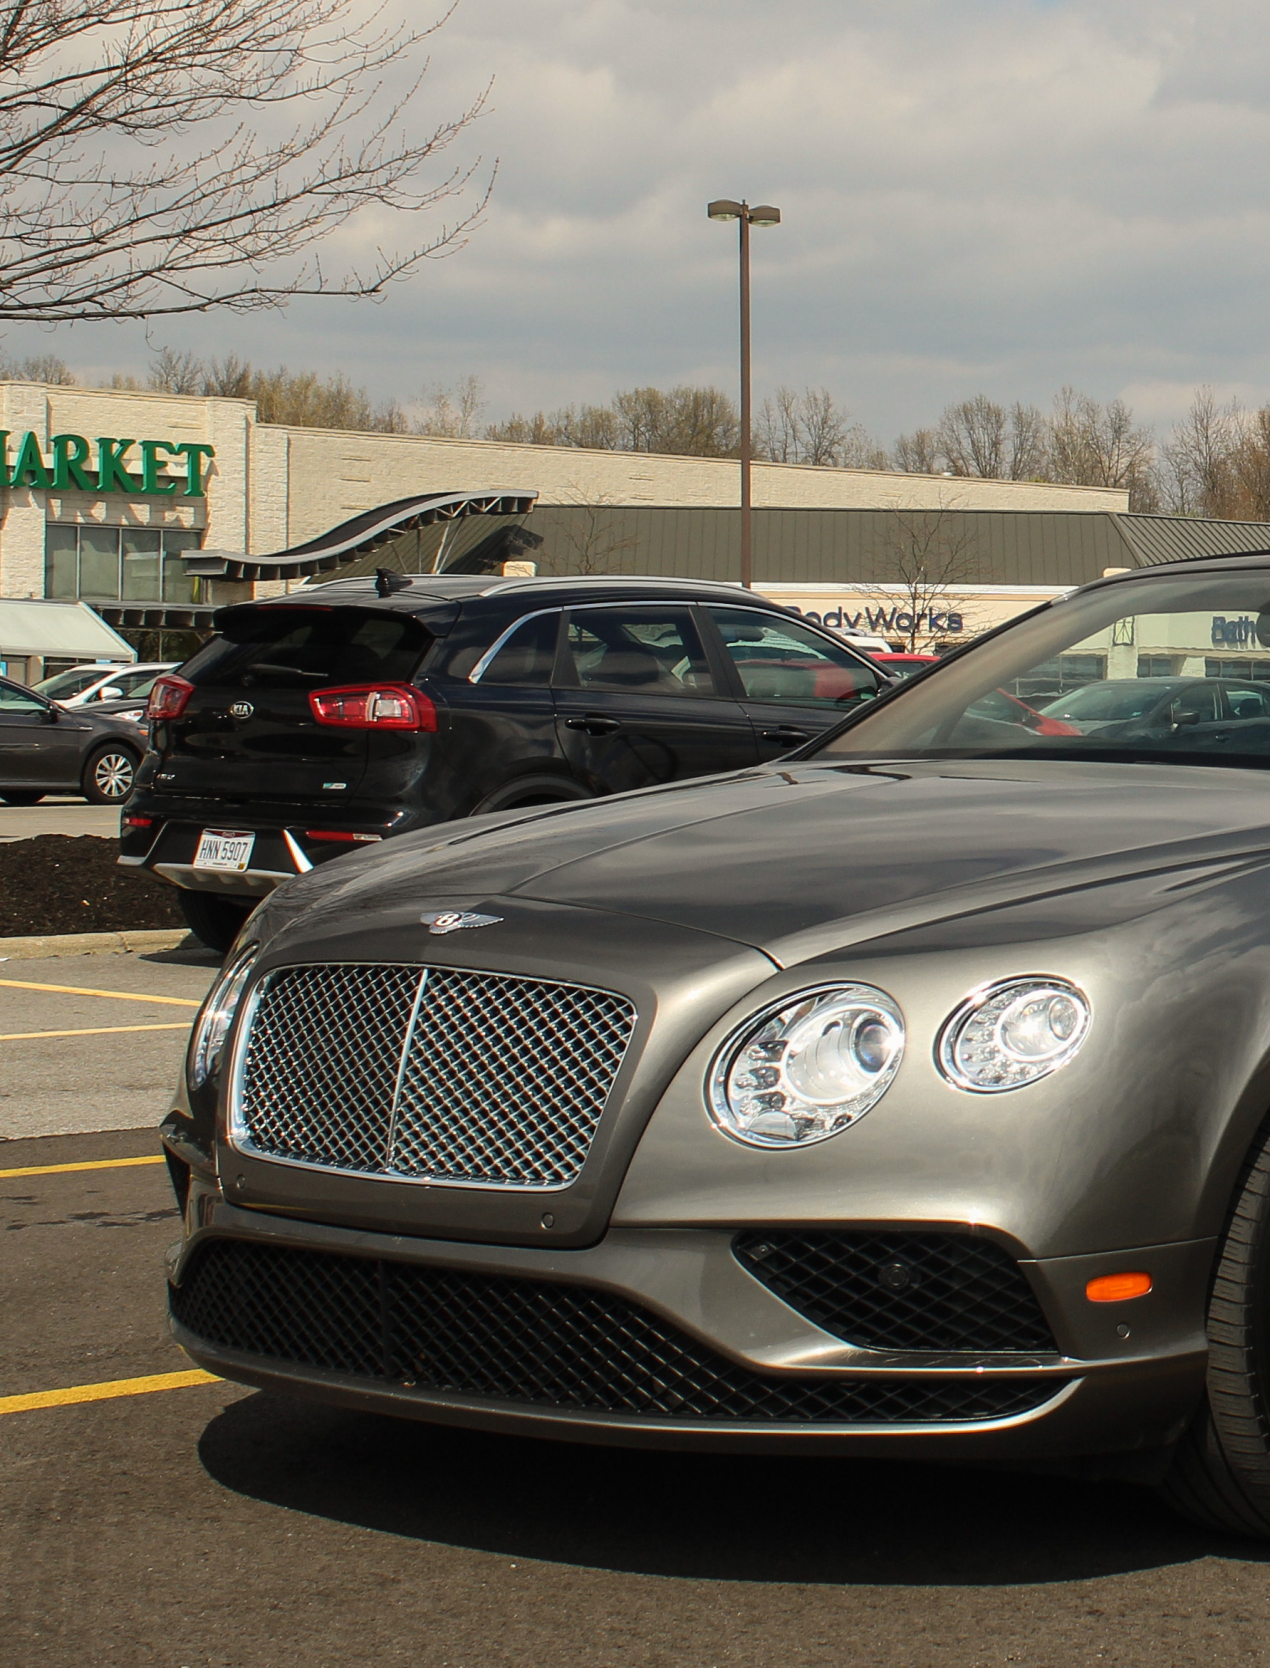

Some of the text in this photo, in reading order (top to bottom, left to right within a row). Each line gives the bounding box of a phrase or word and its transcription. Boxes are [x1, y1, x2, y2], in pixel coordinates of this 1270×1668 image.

[0, 430, 216, 497] ARKET
[865, 606, 964, 633] Works
[1211, 615, 1256, 644] Bath
[233, 704, 249, 715] KIA
[200, 839, 249, 862] HNN 5907
